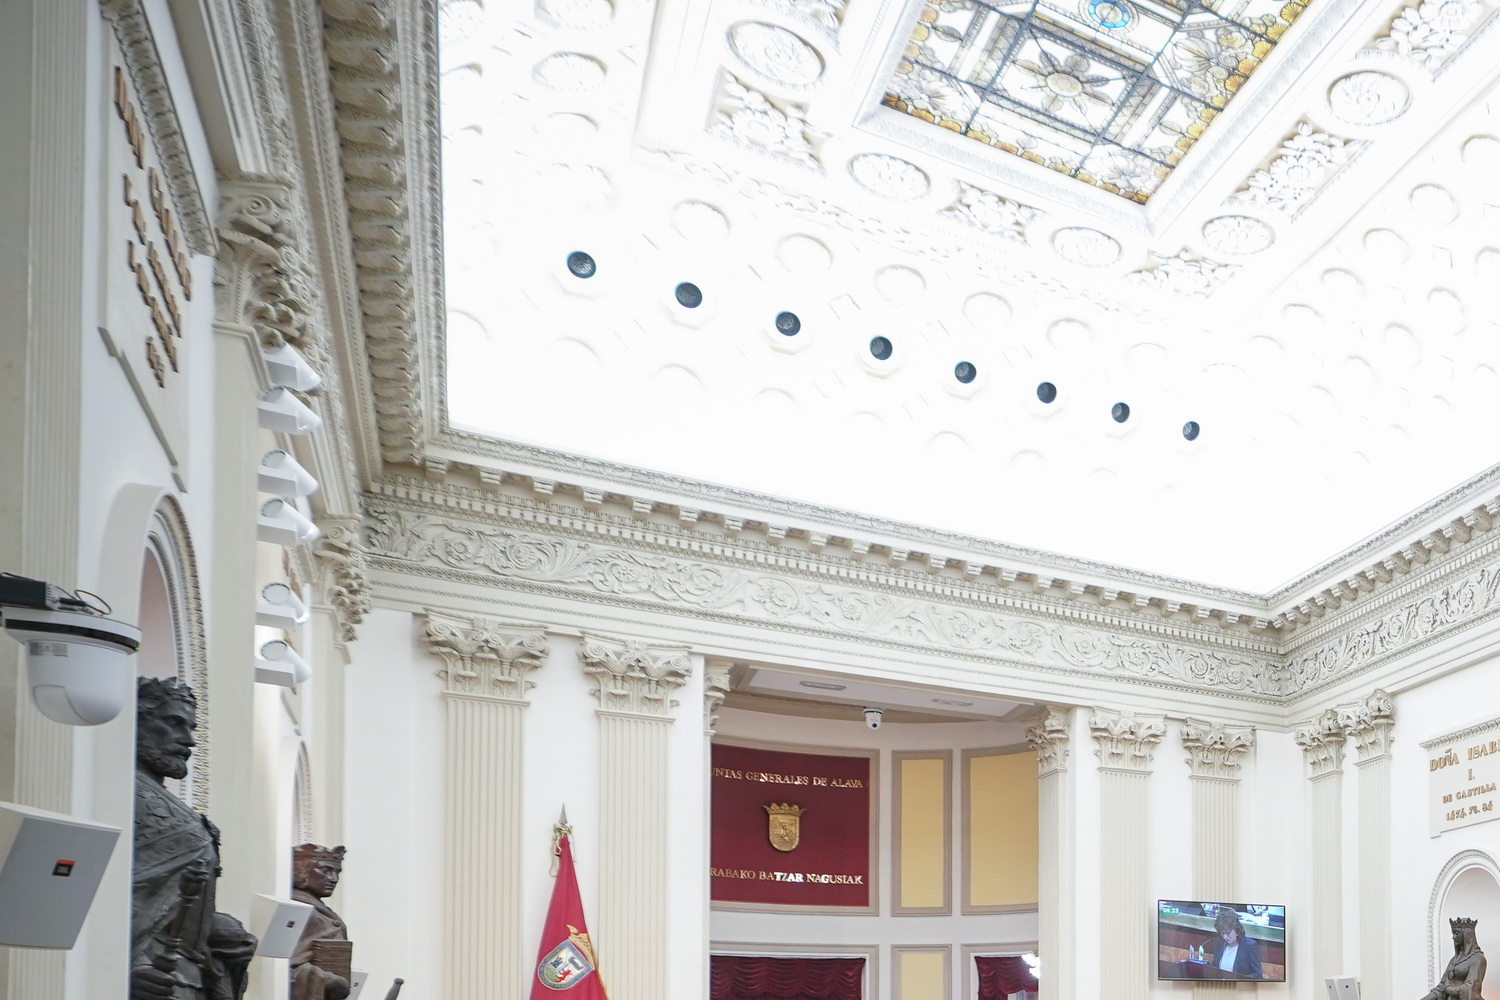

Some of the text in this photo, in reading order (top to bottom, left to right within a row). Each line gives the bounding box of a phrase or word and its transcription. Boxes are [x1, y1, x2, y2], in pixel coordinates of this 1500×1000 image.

[1430, 748, 1459, 772] DOÑA
[745, 772, 808, 785] GENERALES
[812, 776, 827, 786] DE
[1443, 783, 1496, 803] DE CASTILLA
[759, 871, 804, 882] BATZAR
[806, 874, 863, 884] NAGUSIAK
